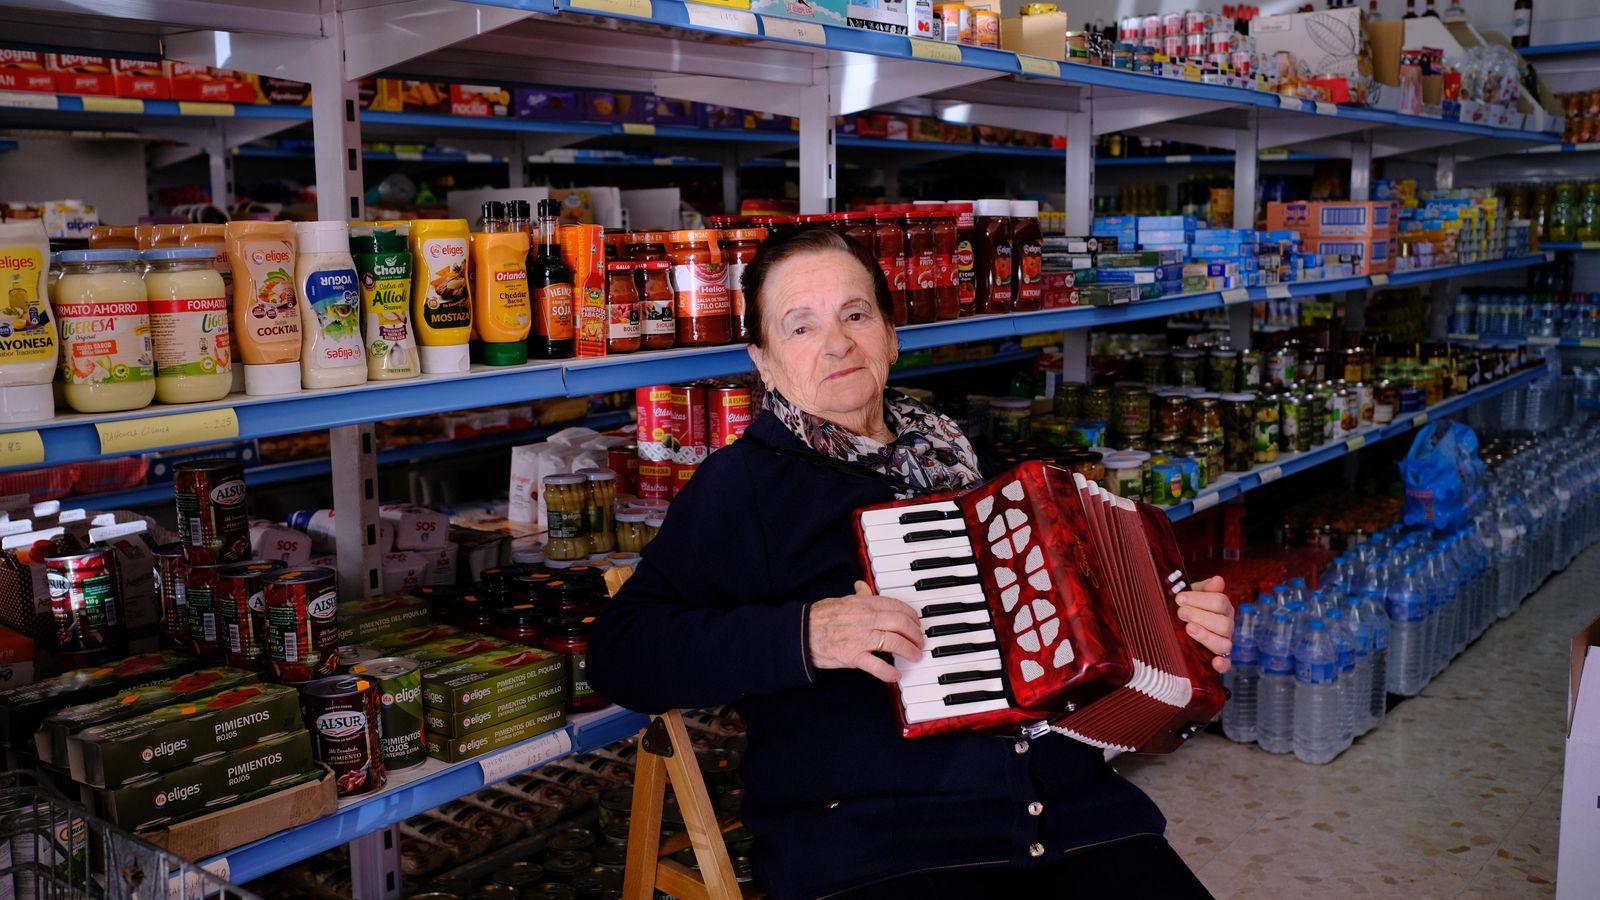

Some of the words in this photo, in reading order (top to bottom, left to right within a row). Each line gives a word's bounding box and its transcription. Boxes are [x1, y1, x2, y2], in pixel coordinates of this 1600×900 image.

[266, 250, 289, 263] eliges
[442, 245, 464, 257] eliges
[321, 276, 353, 286] YOGUR
[496, 271, 526, 281] Orlando
[550, 287, 571, 298] HEINZ
[93, 303, 138, 315] AHORRO
[552, 306, 571, 316] SOJA
[431, 312, 470, 323] MOSTAZA
[257, 325, 299, 337] COCKTAIL
[327, 347, 353, 360] eliges
[416, 522, 436, 531] SOS
[277, 540, 298, 551] SOS
[360, 618, 390, 630] PIMIENTOS
[391, 615, 402, 623] DEL
[402, 608, 427, 620] PIQUILLO
[497, 673, 526, 688] PIMIENTOS
[526, 670, 537, 679] DEL
[537, 662, 561, 676] PIQUILLO
[470, 687, 491, 700] eliges
[497, 698, 526, 712] PIMIENTOS
[527, 694, 538, 703] DEL
[538, 685, 562, 698] PIQUILLO
[214, 710, 270, 735] PIMIENTOS
[320, 716, 362, 730] ALSUR
[471, 712, 491, 725] eliges
[495, 723, 525, 738] PIMIENTOS
[525, 719, 536, 729] DEL
[536, 710, 561, 724] PIQUILLO
[216, 731, 237, 743] ROJOS
[383, 730, 421, 744] PIMIENTOS
[154, 740, 188, 758] eliges
[384, 743, 409, 753] ROJOS
[428, 742, 440, 753] ges
[467, 737, 488, 750] eliges
[330, 753, 362, 761] PIMIENTO
[227, 752, 283, 778] PIMIENTOS
[229, 774, 250, 786] ROJOS
[167, 784, 200, 802] eliges
